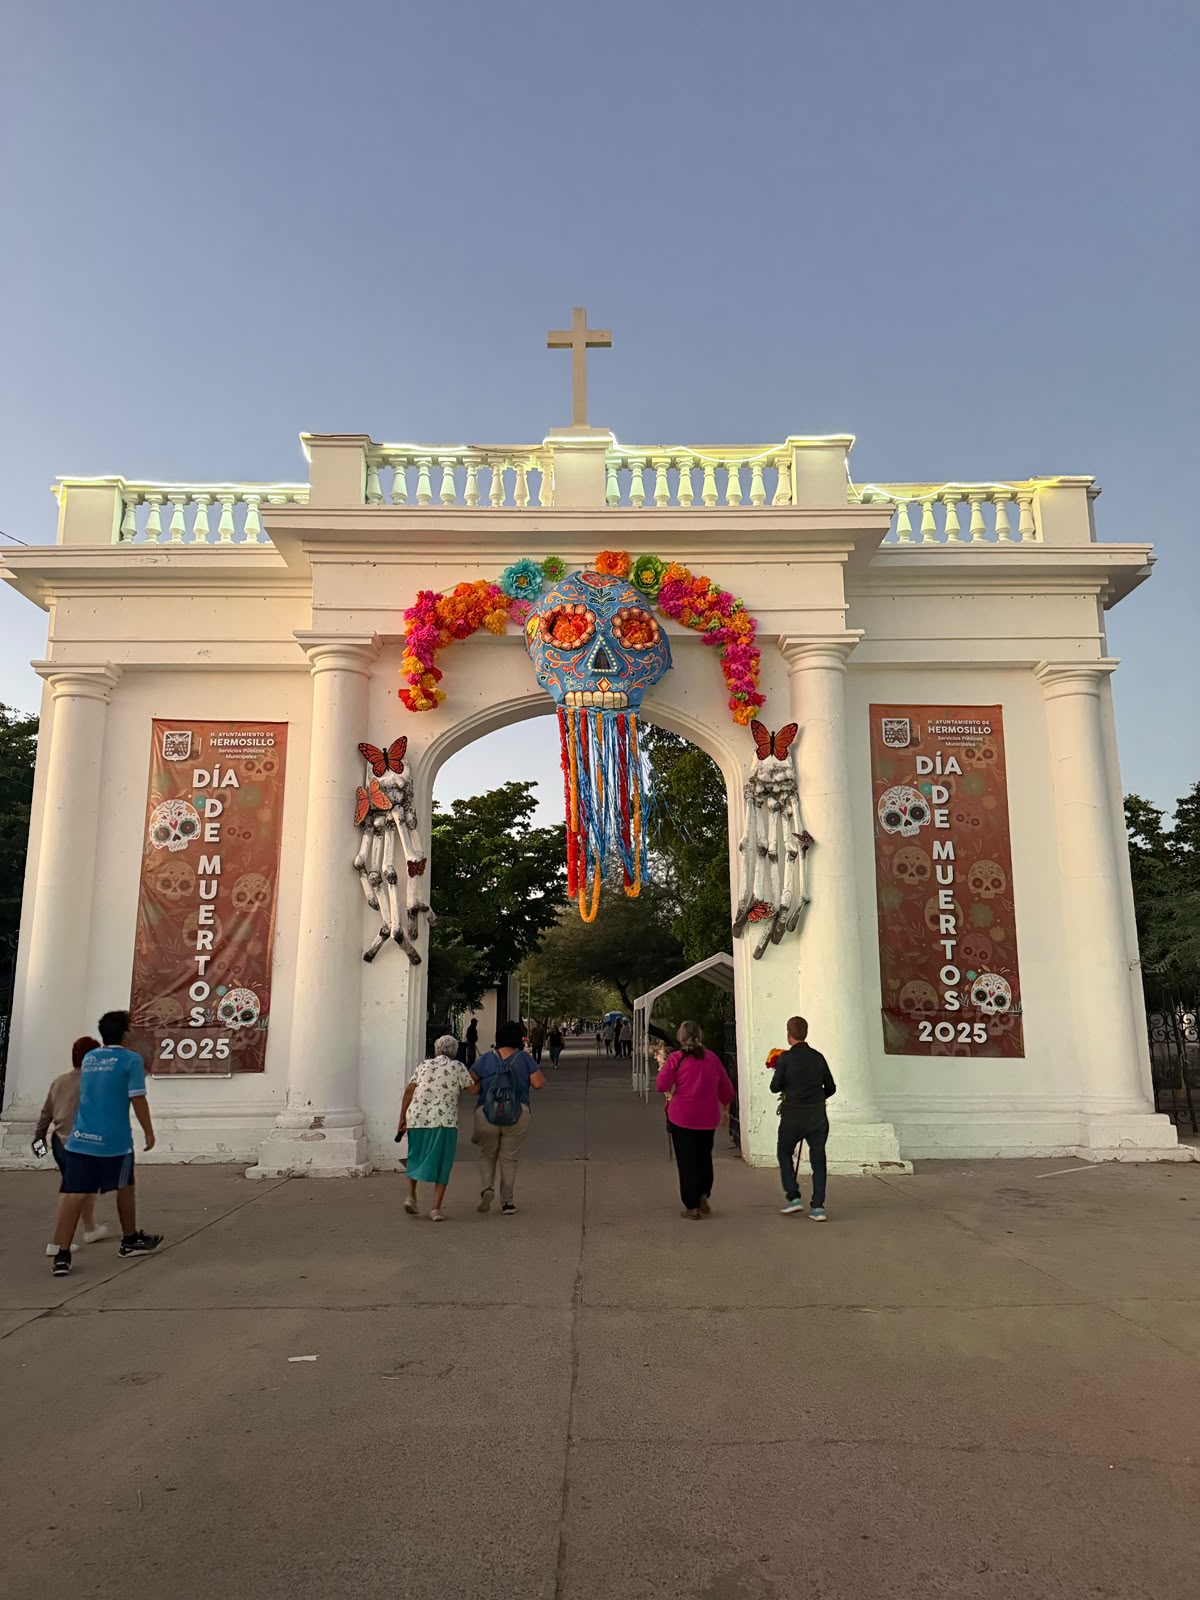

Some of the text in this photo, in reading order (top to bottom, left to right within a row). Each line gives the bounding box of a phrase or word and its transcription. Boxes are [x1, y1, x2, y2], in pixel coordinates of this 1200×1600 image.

[210, 738, 275, 746] HERMOSILLO
[928, 726, 991, 734] HERMOSILLO
[916, 751, 963, 775] DÍA
[192, 764, 240, 788] DÍA
[931, 785, 950, 829] DE
[204, 798, 224, 843] DE
[932, 840, 961, 1012] MUERTOS
[189, 855, 221, 1028] MUERTOS
[918, 1021, 988, 1044] 2025
[159, 1038, 230, 1060] 2025
